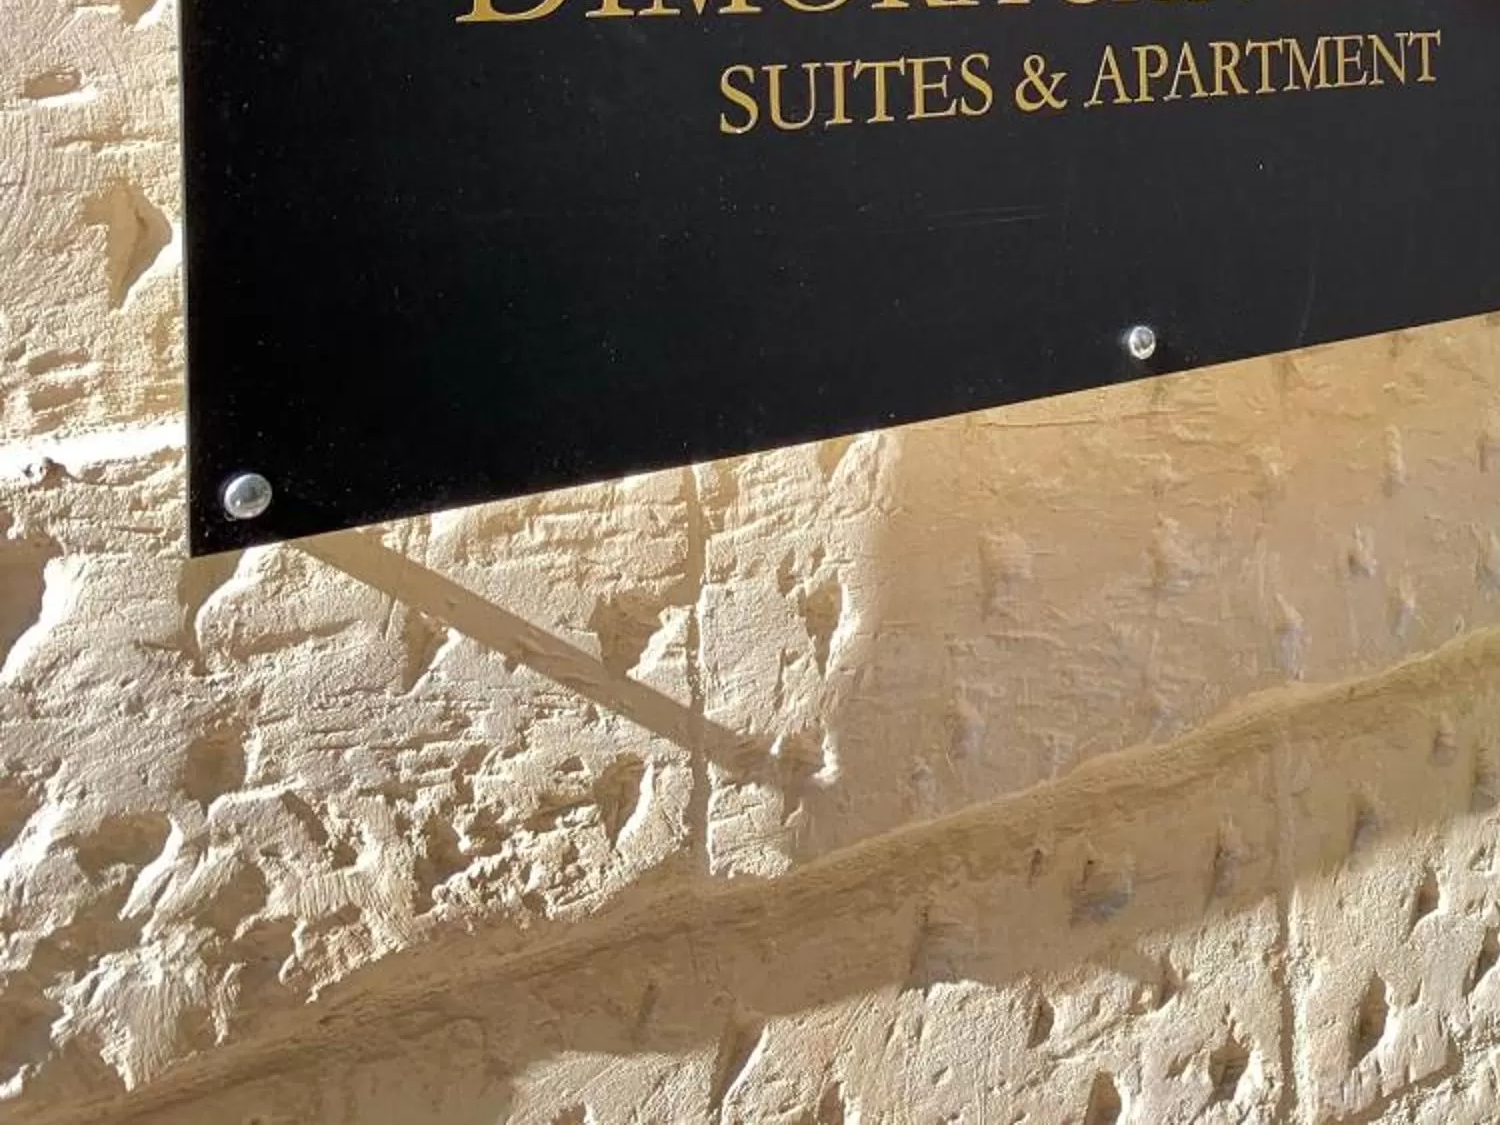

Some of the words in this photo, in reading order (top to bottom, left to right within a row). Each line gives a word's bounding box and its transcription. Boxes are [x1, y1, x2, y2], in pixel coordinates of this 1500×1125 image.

[720, 53, 993, 134] SUITES
[1015, 54, 1068, 111] &
[1084, 30, 1441, 108] APARTMENT
